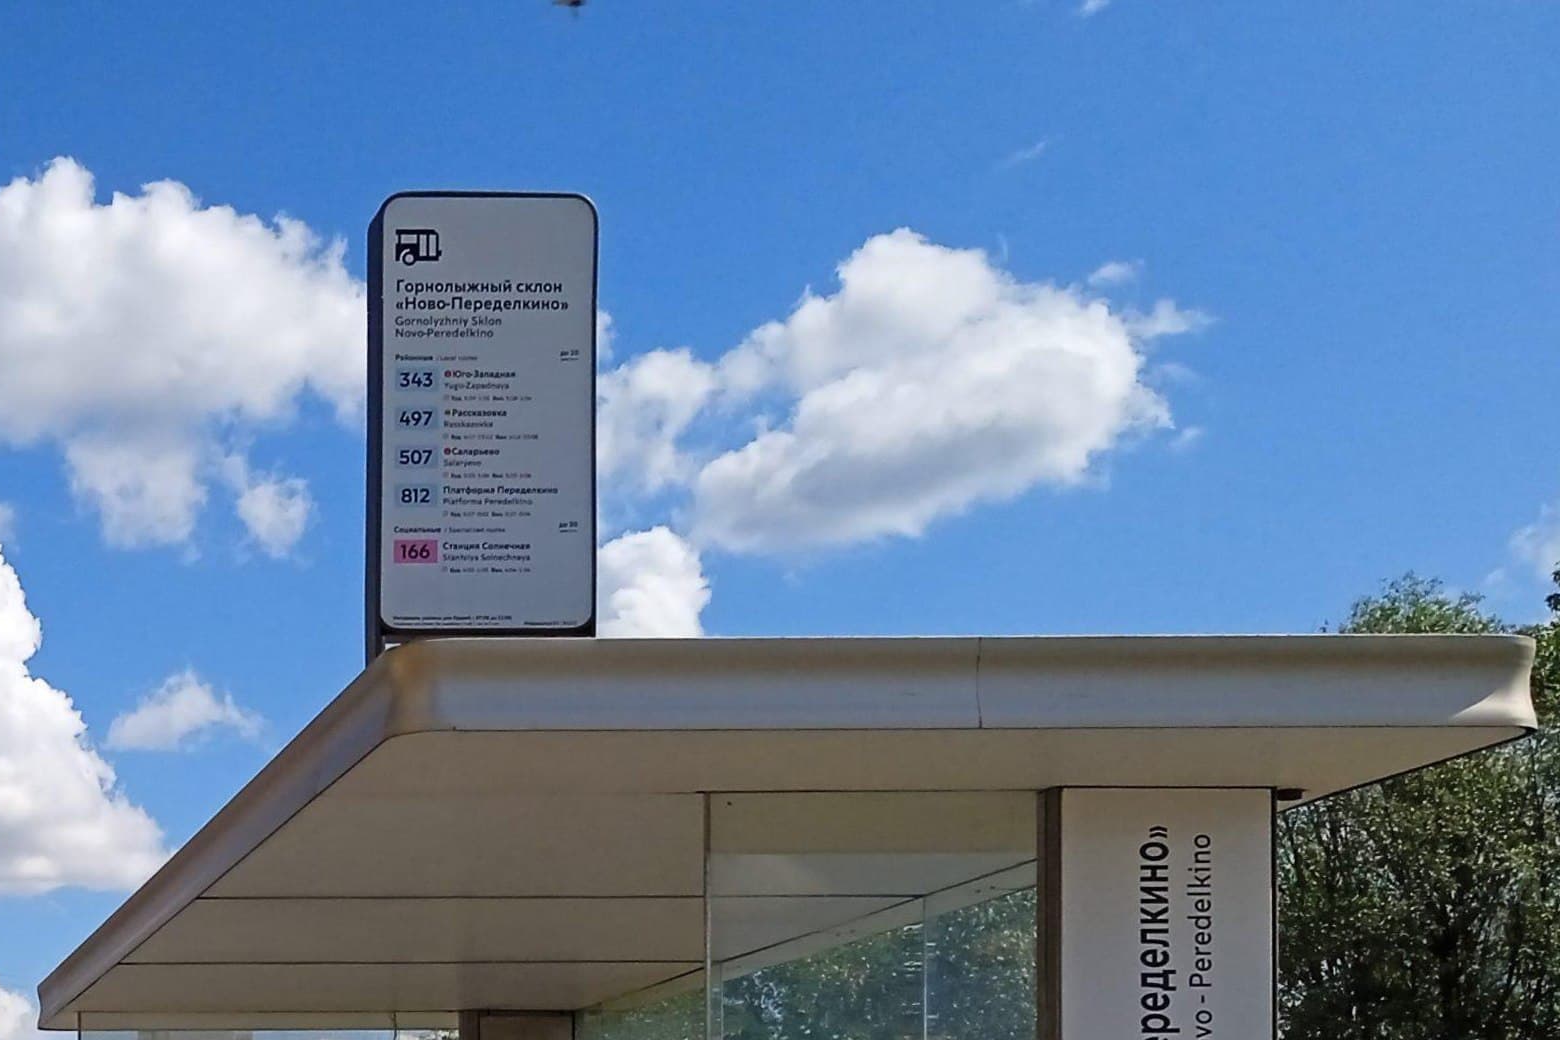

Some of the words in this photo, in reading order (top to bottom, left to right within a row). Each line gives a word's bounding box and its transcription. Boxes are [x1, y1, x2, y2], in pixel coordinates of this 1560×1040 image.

[396, 279, 512, 295] Горнолыжный
[516, 282, 562, 293] склон
[395, 296, 568, 312] «Ново-Переделкино»
[395, 316, 468, 328] Gornolyzhniy
[471, 316, 502, 326] Sklon
[395, 328, 494, 338] Novo-Peredelkino
[399, 372, 433, 387] 343
[399, 411, 433, 426] 497
[399, 449, 433, 465] 507
[400, 488, 431, 504] 812
[400, 543, 430, 560] 166
[1187, 833, 1213, 988] Peredelkino
